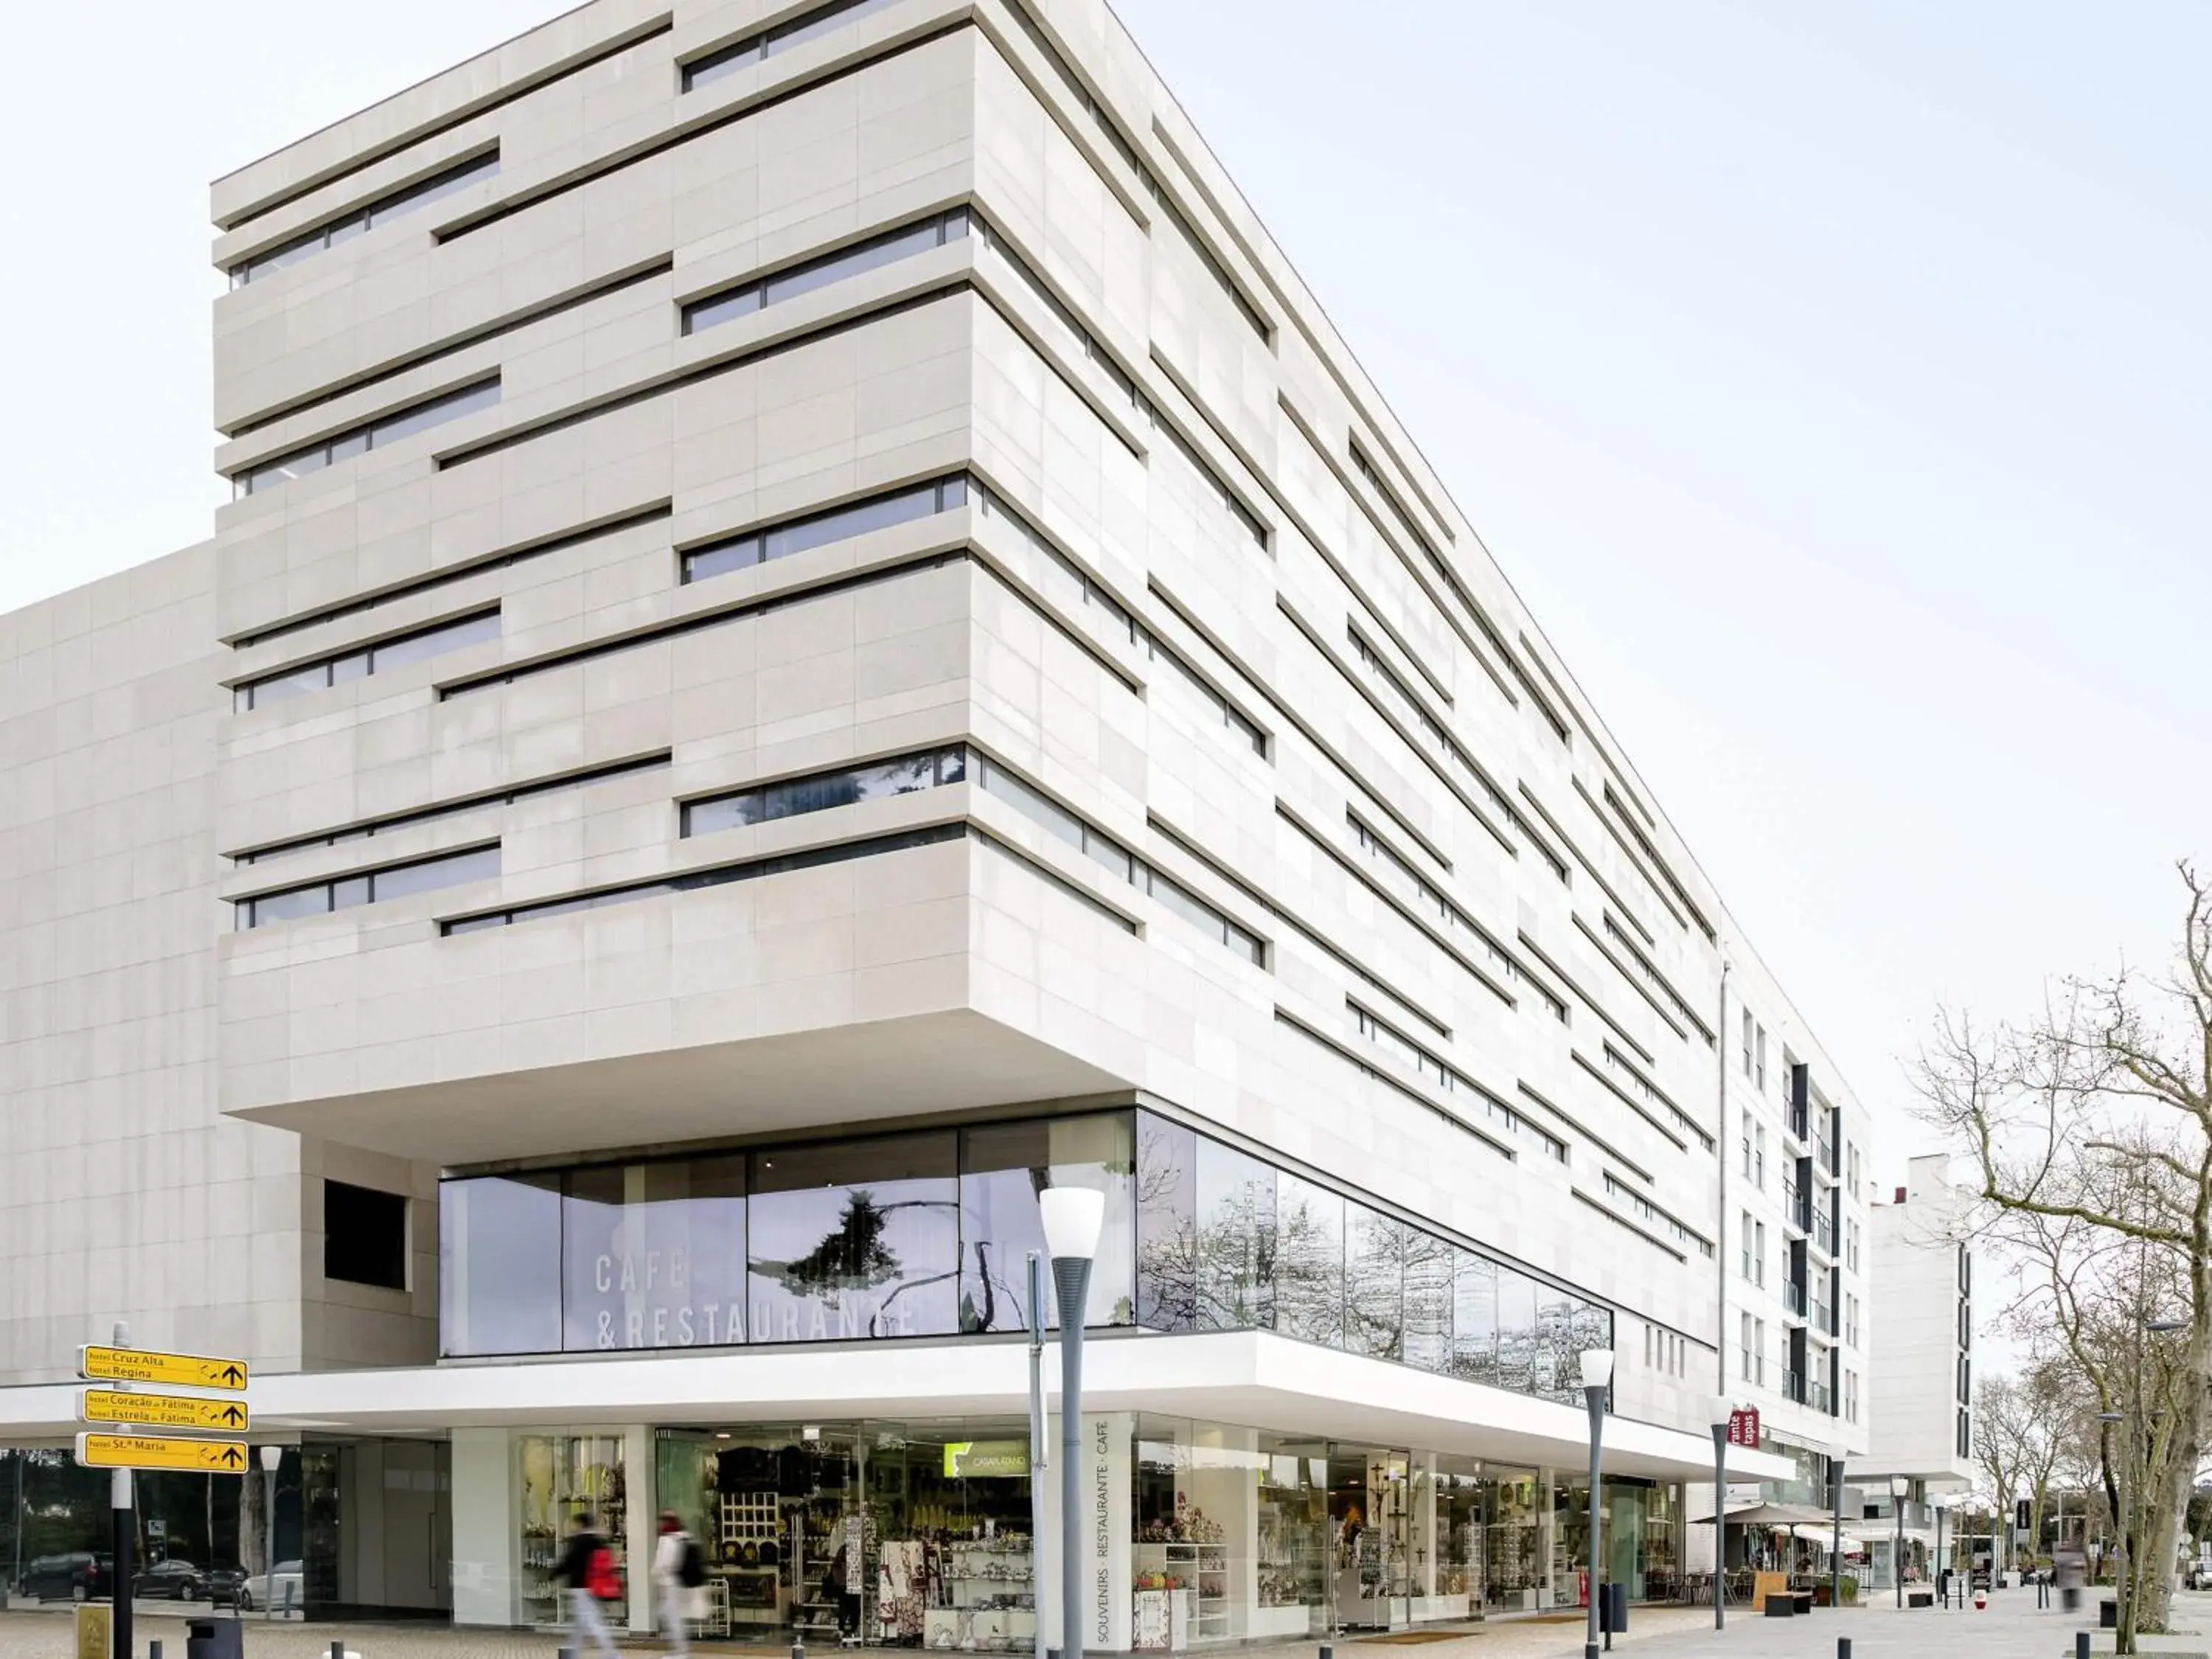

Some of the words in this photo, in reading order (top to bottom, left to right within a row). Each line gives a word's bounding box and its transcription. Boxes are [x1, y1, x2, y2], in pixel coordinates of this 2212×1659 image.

[112, 1352, 139, 1364] Cruz
[142, 1356, 164, 1366] Alta
[113, 1366, 152, 1379] Regina
[111, 1410, 150, 1421] Estrela
[1744, 1415, 1756, 1444] tapas
[135, 1440, 166, 1451] Maria
[1096, 1465, 1109, 1557] RESTAURANTE
[1096, 1568, 1109, 1644] SOUVENIRS
